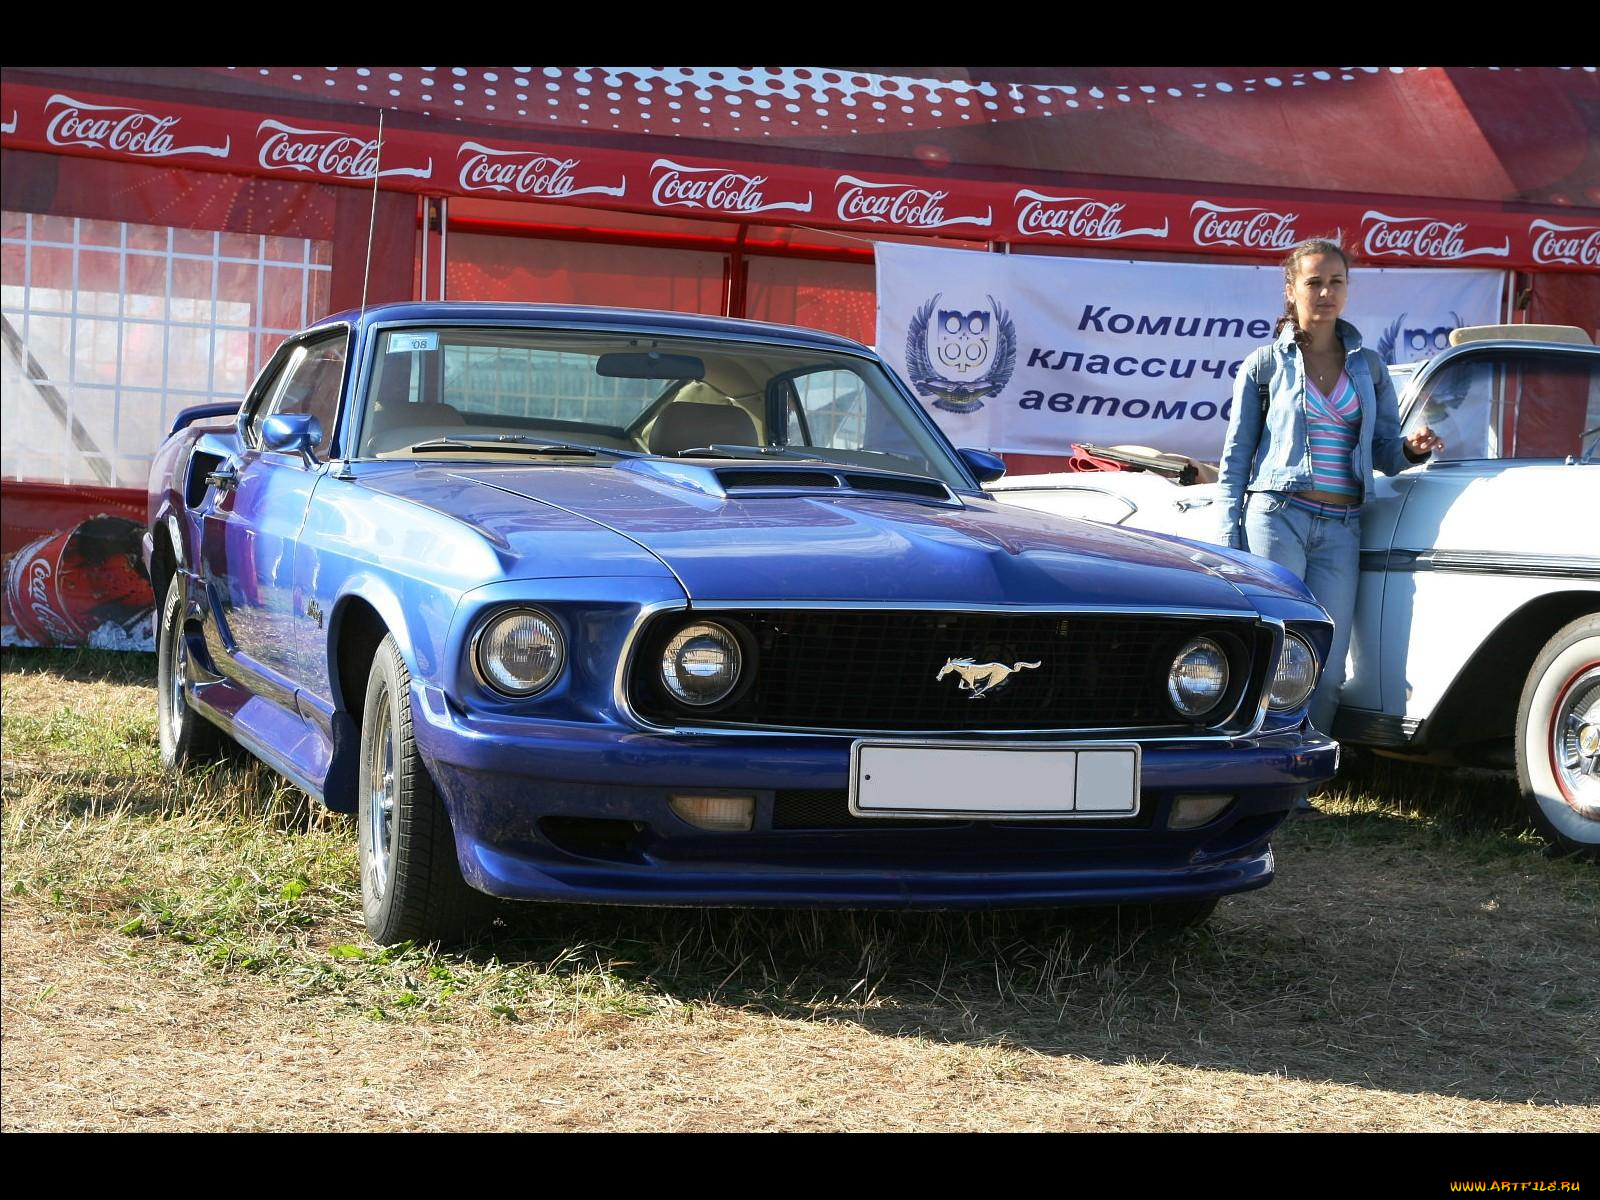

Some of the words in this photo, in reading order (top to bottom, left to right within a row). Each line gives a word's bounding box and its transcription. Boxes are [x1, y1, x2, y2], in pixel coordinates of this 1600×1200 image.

[44, 94, 182, 157] Coca-Cola
[257, 119, 385, 179] Coca-Cola
[456, 141, 580, 198] Coca-Cola
[650, 158, 768, 213] Coca-Cola
[834, 175, 949, 228] Coca-Cola
[1013, 189, 1126, 241] Coca-Cola
[1190, 200, 1298, 250] Coca-Cola
[1360, 210, 1468, 260] Coca-Cola
[1529, 219, 1600, 268] Coca-C
[1077, 304, 1279, 339] Комите
